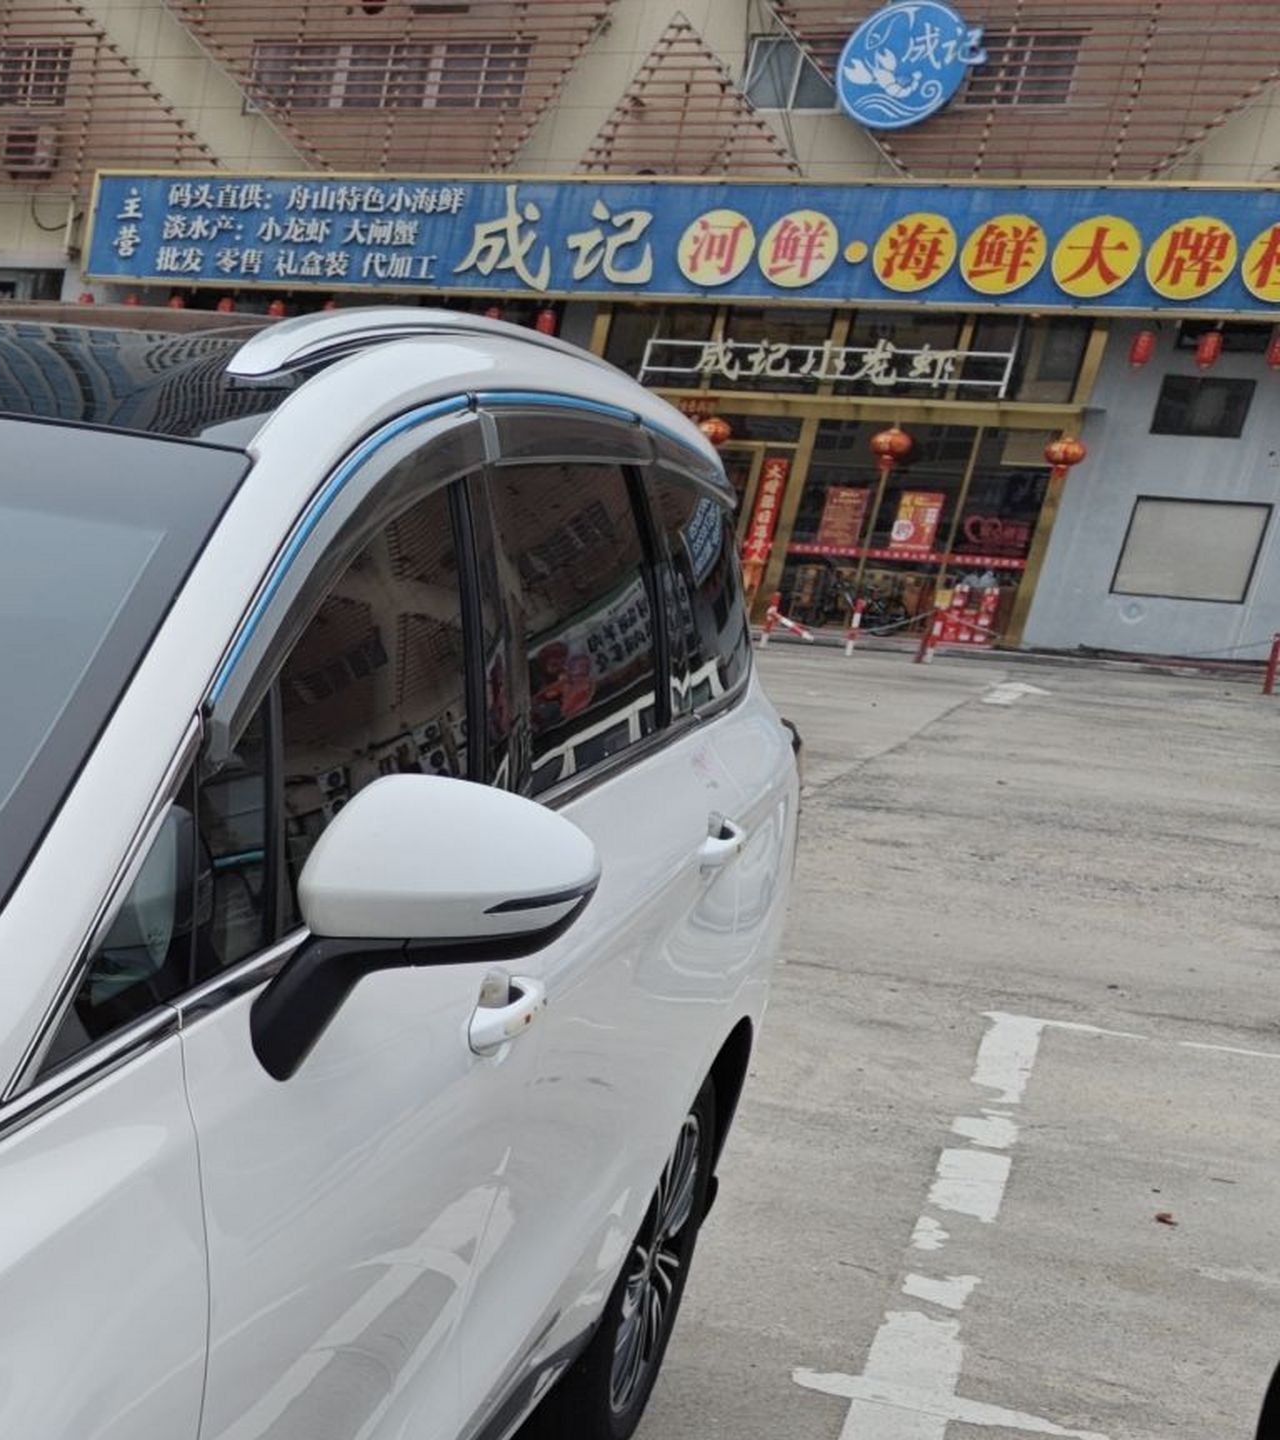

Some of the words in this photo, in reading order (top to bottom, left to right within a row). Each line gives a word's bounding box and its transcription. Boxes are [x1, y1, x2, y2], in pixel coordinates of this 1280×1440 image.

[901, 22, 989, 69] 成记
[112, 187, 143, 258] 主营
[343, 217, 420, 246] 大闸蟹
[454, 184, 654, 291] 成记
[155, 246, 204, 274] 批发
[215, 248, 264, 276] 零售
[274, 250, 349, 279] 礼盒装
[361, 251, 438, 280] 代加工
[693, 338, 958, 388] 成记小龙虾
